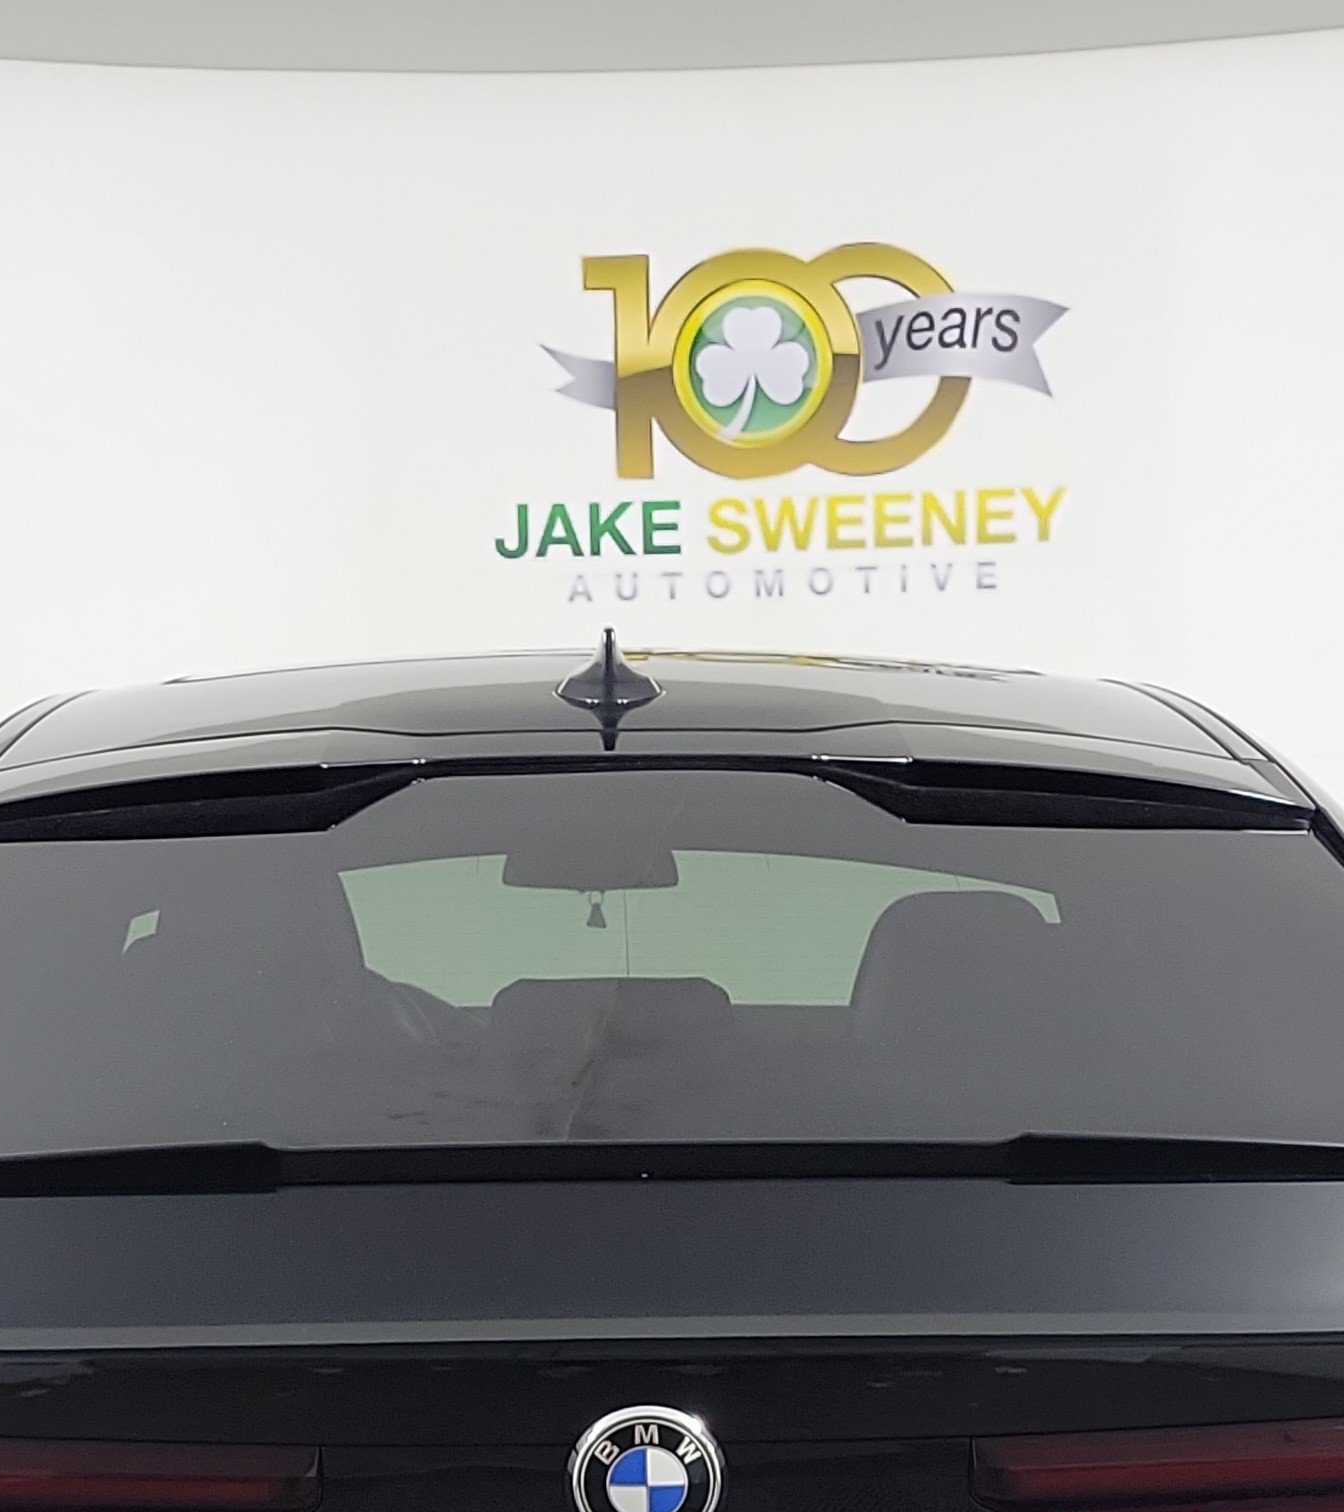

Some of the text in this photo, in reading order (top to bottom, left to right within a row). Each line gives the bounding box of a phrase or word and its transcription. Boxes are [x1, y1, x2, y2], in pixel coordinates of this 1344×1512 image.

[582, 242, 1020, 479] 100 years
[495, 485, 1067, 559] JAKE SWEENEY
[568, 562, 999, 603] AUTOMOTIVE
[593, 1423, 702, 1466] BMW
